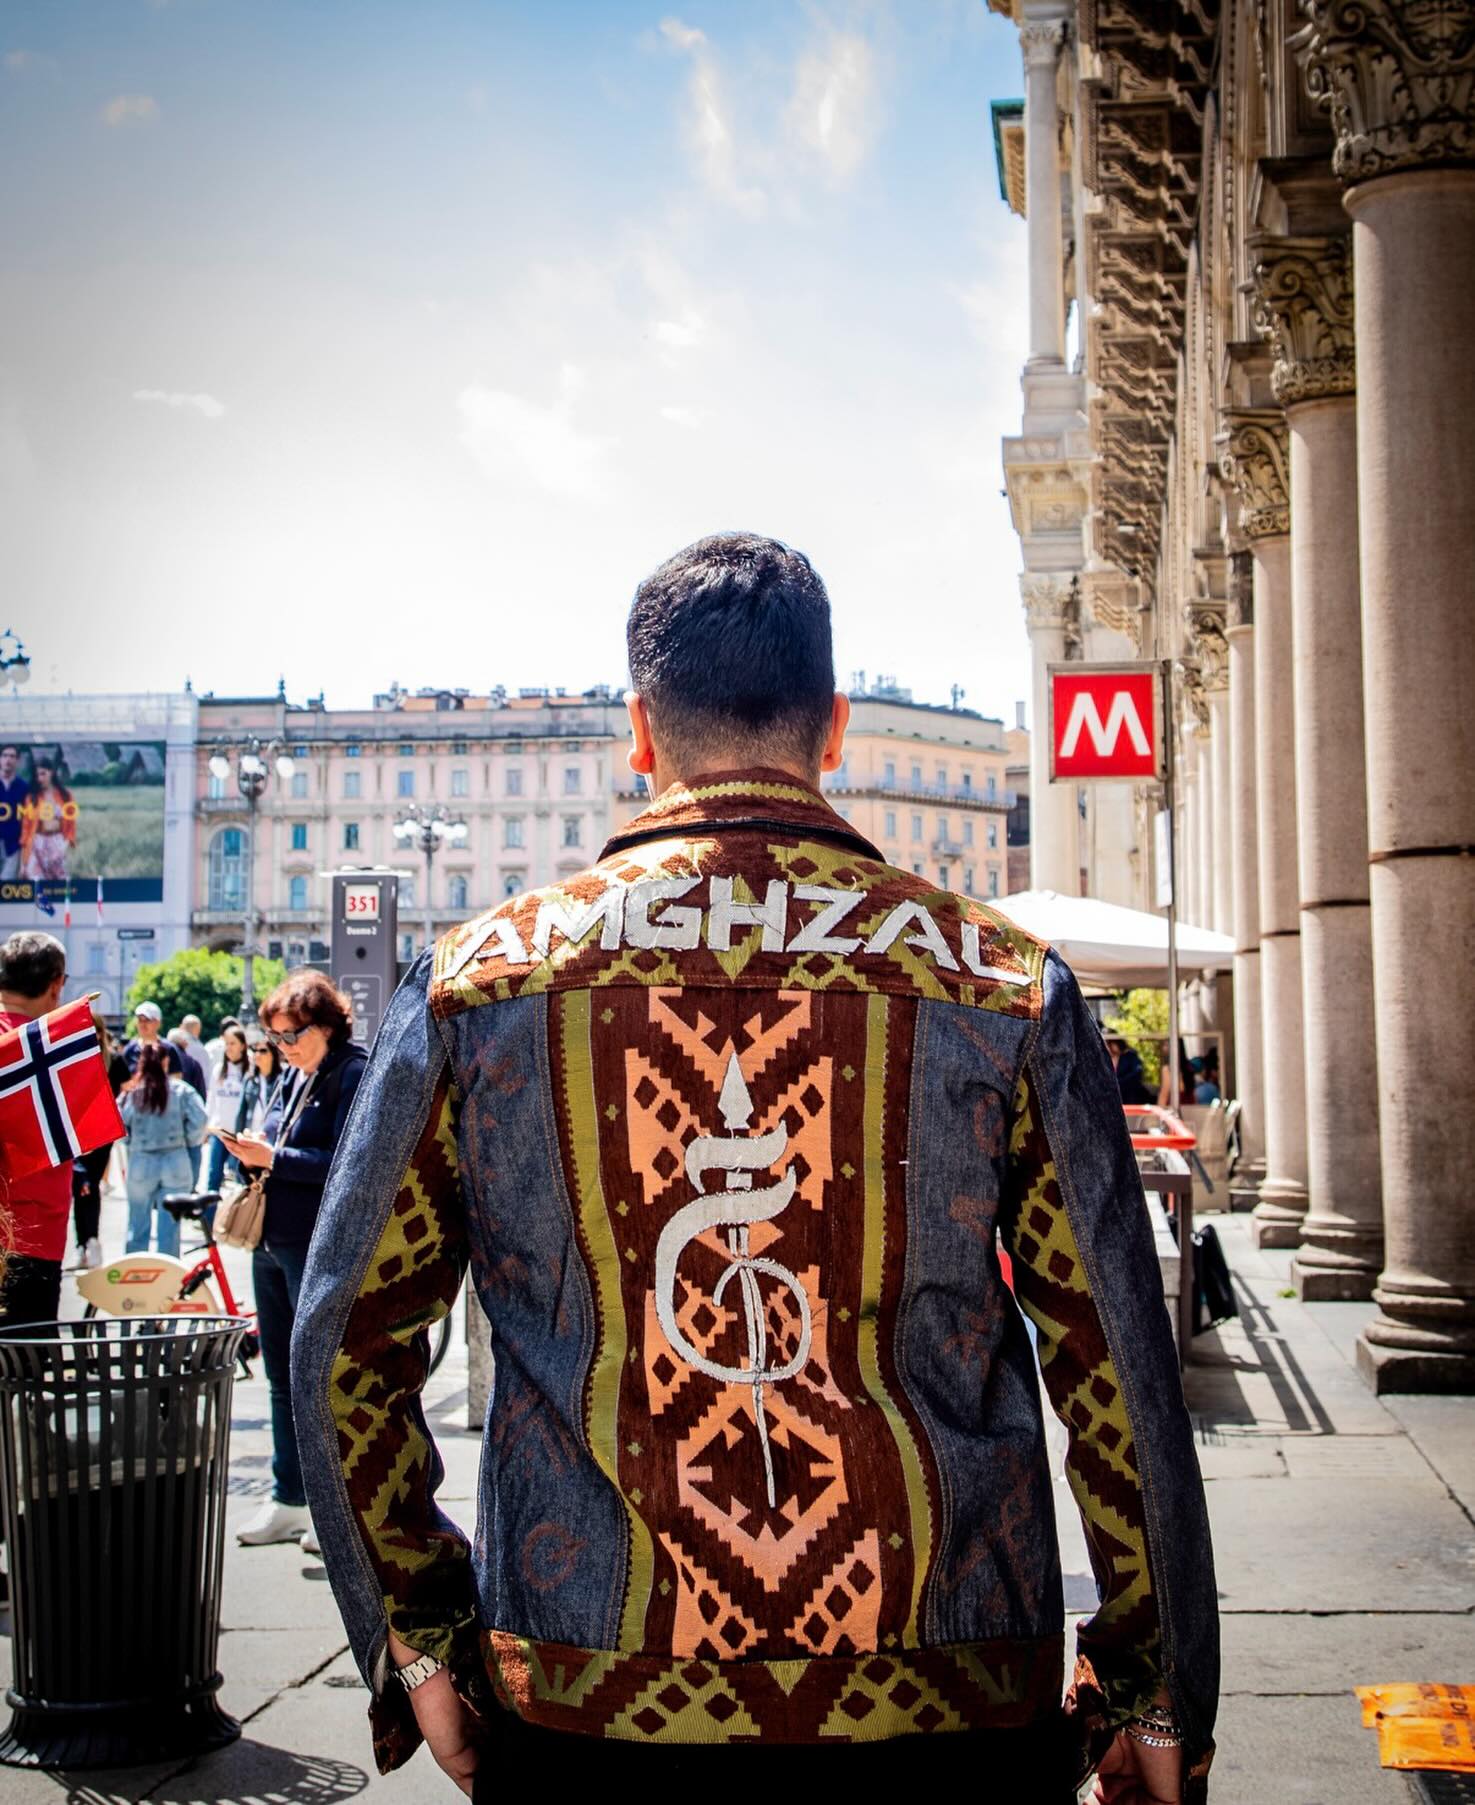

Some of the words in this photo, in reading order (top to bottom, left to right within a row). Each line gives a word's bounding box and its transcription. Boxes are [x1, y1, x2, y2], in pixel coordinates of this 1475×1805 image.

[1059, 692, 1151, 757] M
[1, 884, 33, 899] OVS
[348, 895, 377, 912] 351
[437, 872, 1036, 986] AMGHZAL
